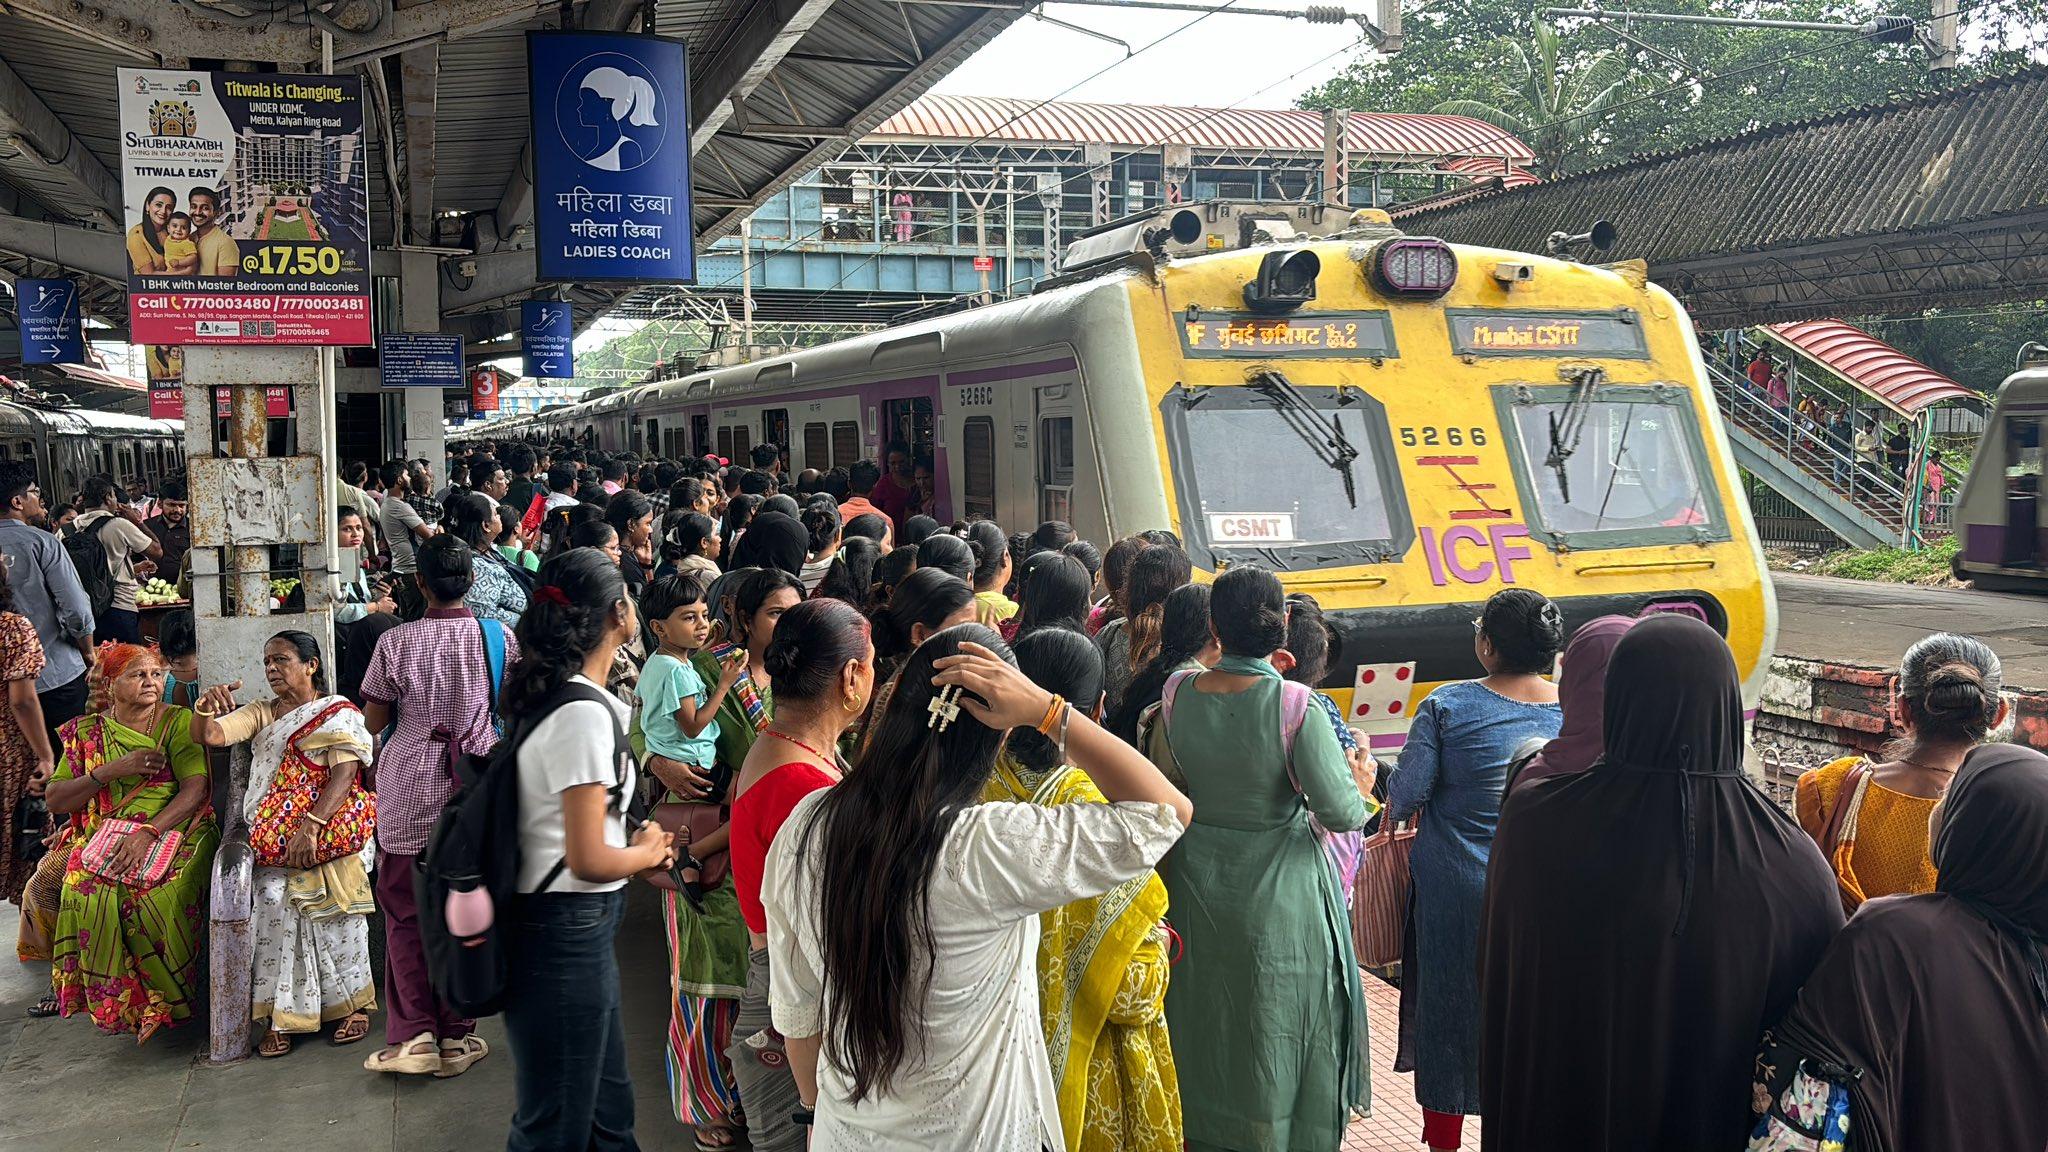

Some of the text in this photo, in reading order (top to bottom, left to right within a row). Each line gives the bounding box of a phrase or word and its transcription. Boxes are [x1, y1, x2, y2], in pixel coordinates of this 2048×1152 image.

[225, 81, 270, 97] Titwala
[273, 83, 283, 98] is
[249, 102, 306, 116] UNDER KDMC,
[250, 115, 341, 128] Metro, Kalyan Ring Road
[134, 167, 218, 178] TITWALA EAST
[556, 186, 672, 215] महिला डब्बा
[570, 219, 662, 239] महिला डिब्बा
[564, 246, 671, 259] LADIES COACH
[142, 280, 359, 291] 1 BHK with Master Bedroom and Balconies
[138, 296, 364, 312] Call 7770003480 / 7770003481
[1216, 323, 1255, 349] मुंबई
[1473, 325, 1580, 346] Mumbai CSMT
[478, 372, 493, 395] 3
[154, 391, 171, 399] Call
[960, 387, 992, 406] 5266C
[1400, 426, 1487, 446] 5266
[1222, 519, 1280, 536] CSMT
[1418, 524, 1532, 586] ICF
